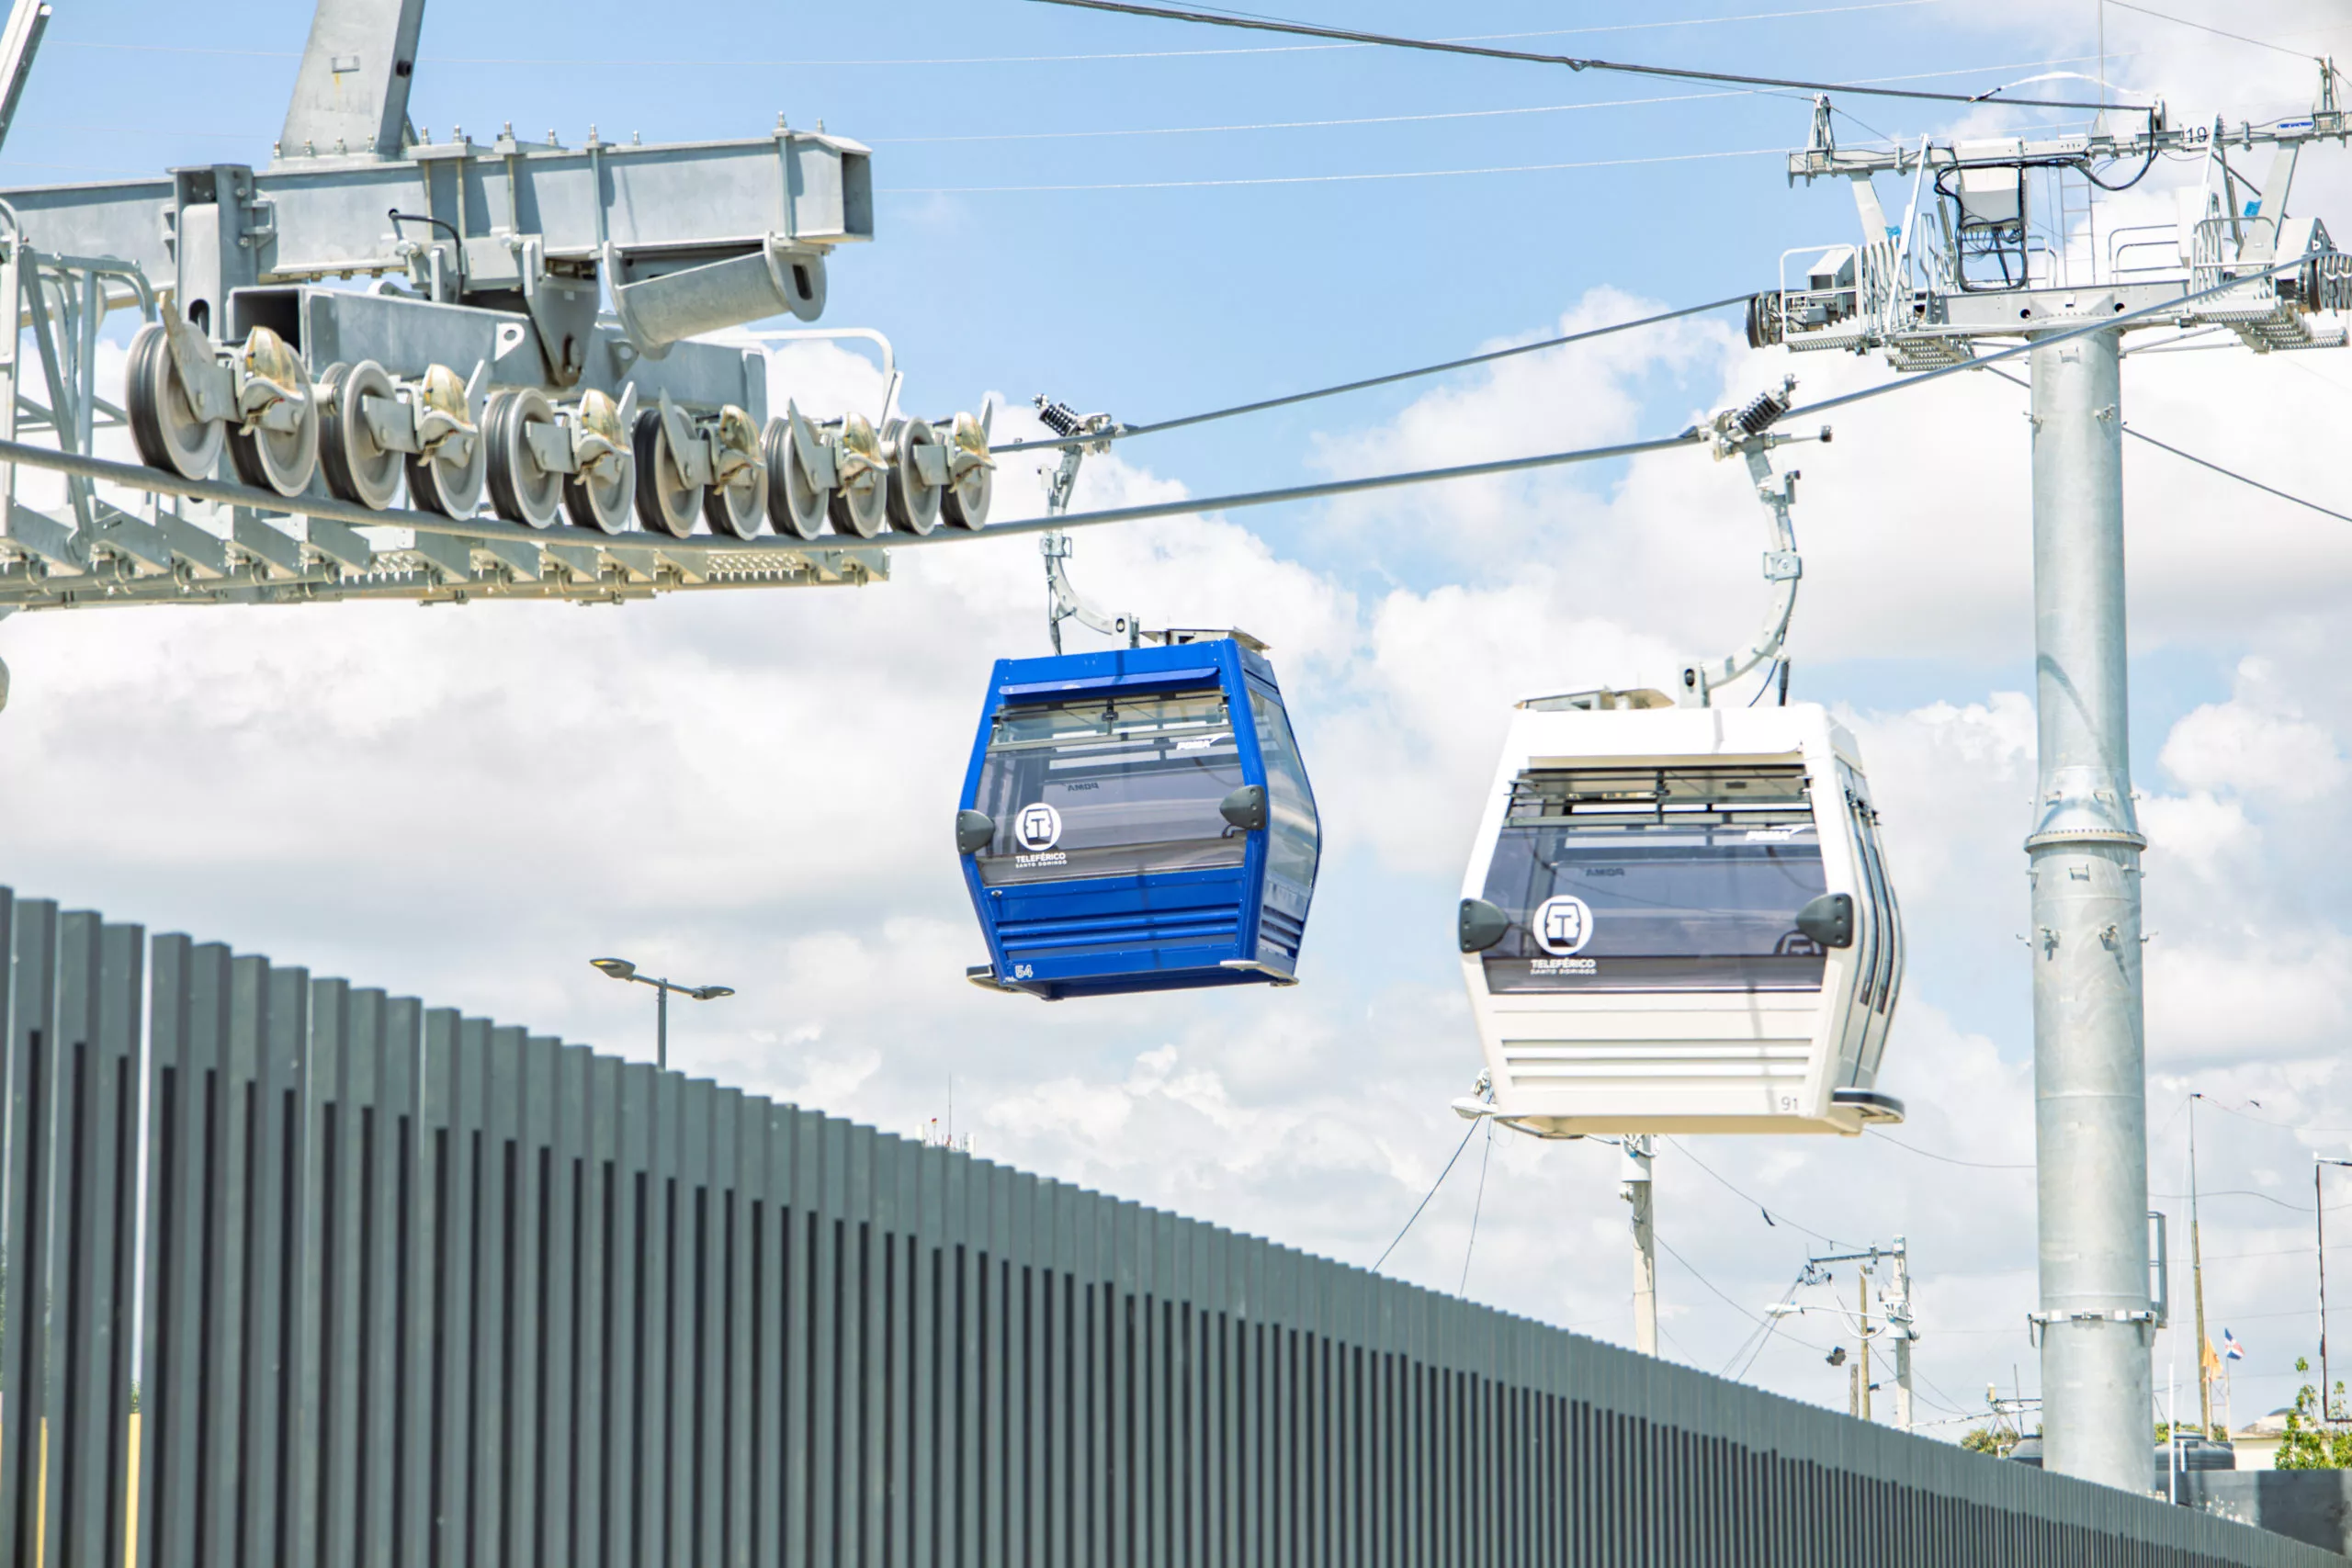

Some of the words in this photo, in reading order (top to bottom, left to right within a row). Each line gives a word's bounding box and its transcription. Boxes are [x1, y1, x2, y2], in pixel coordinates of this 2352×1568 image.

[2186, 127, 2208, 143] 19
[1015, 852, 1066, 863] TELEFÉRICO
[1038, 859, 1068, 867] DOMINGO
[1531, 957, 1597, 969] TELEFÉRICO
[1015, 964, 1034, 979] 54
[1781, 1096, 1798, 1111] 91
